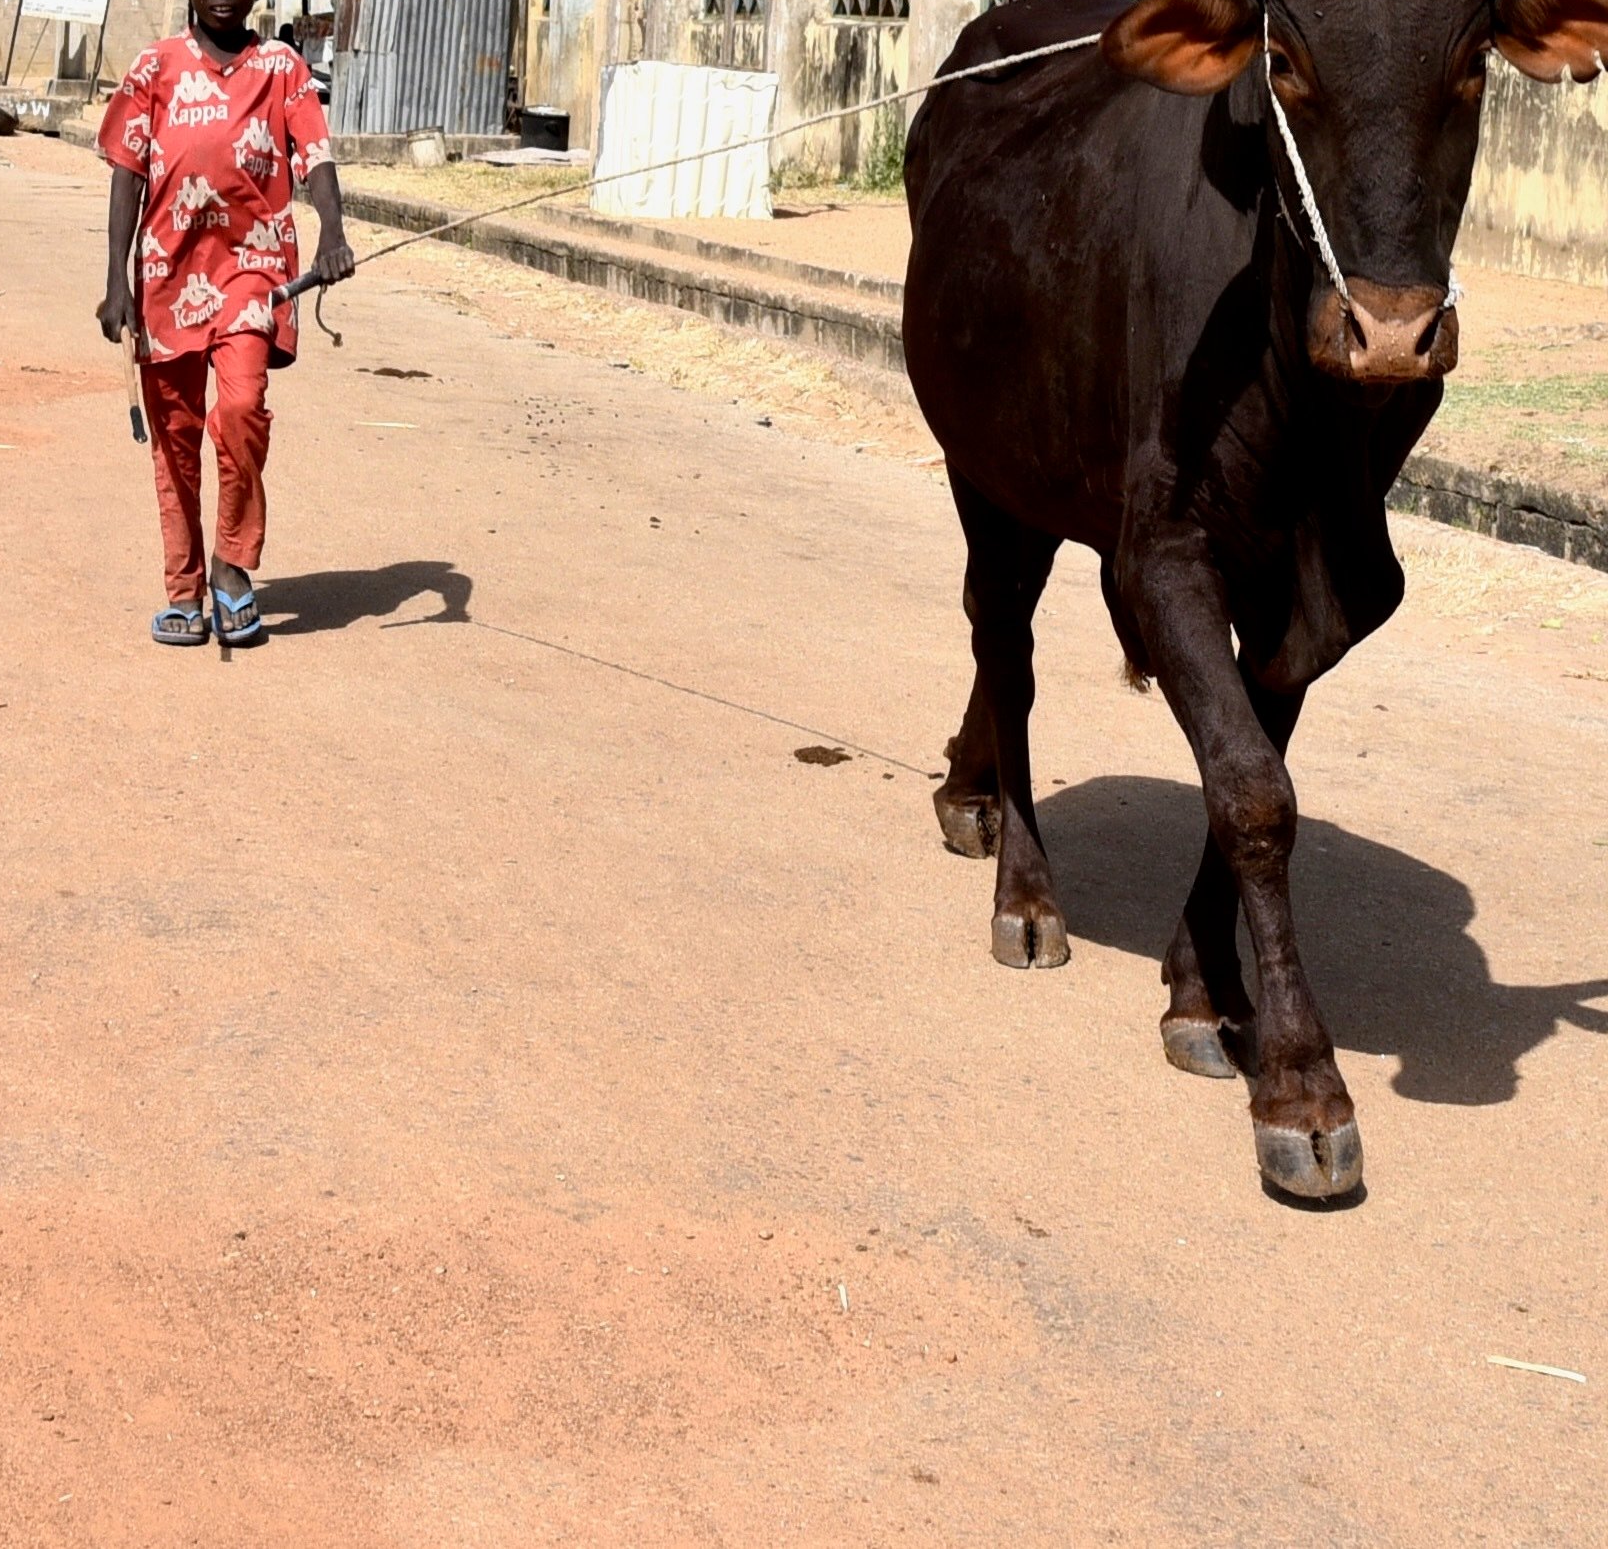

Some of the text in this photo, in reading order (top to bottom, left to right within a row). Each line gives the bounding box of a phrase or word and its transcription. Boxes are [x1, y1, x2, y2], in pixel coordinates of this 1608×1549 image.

[168, 104, 228, 127] Kappa
[235, 148, 279, 179] Kappa
[172, 209, 230, 231] Kappa
